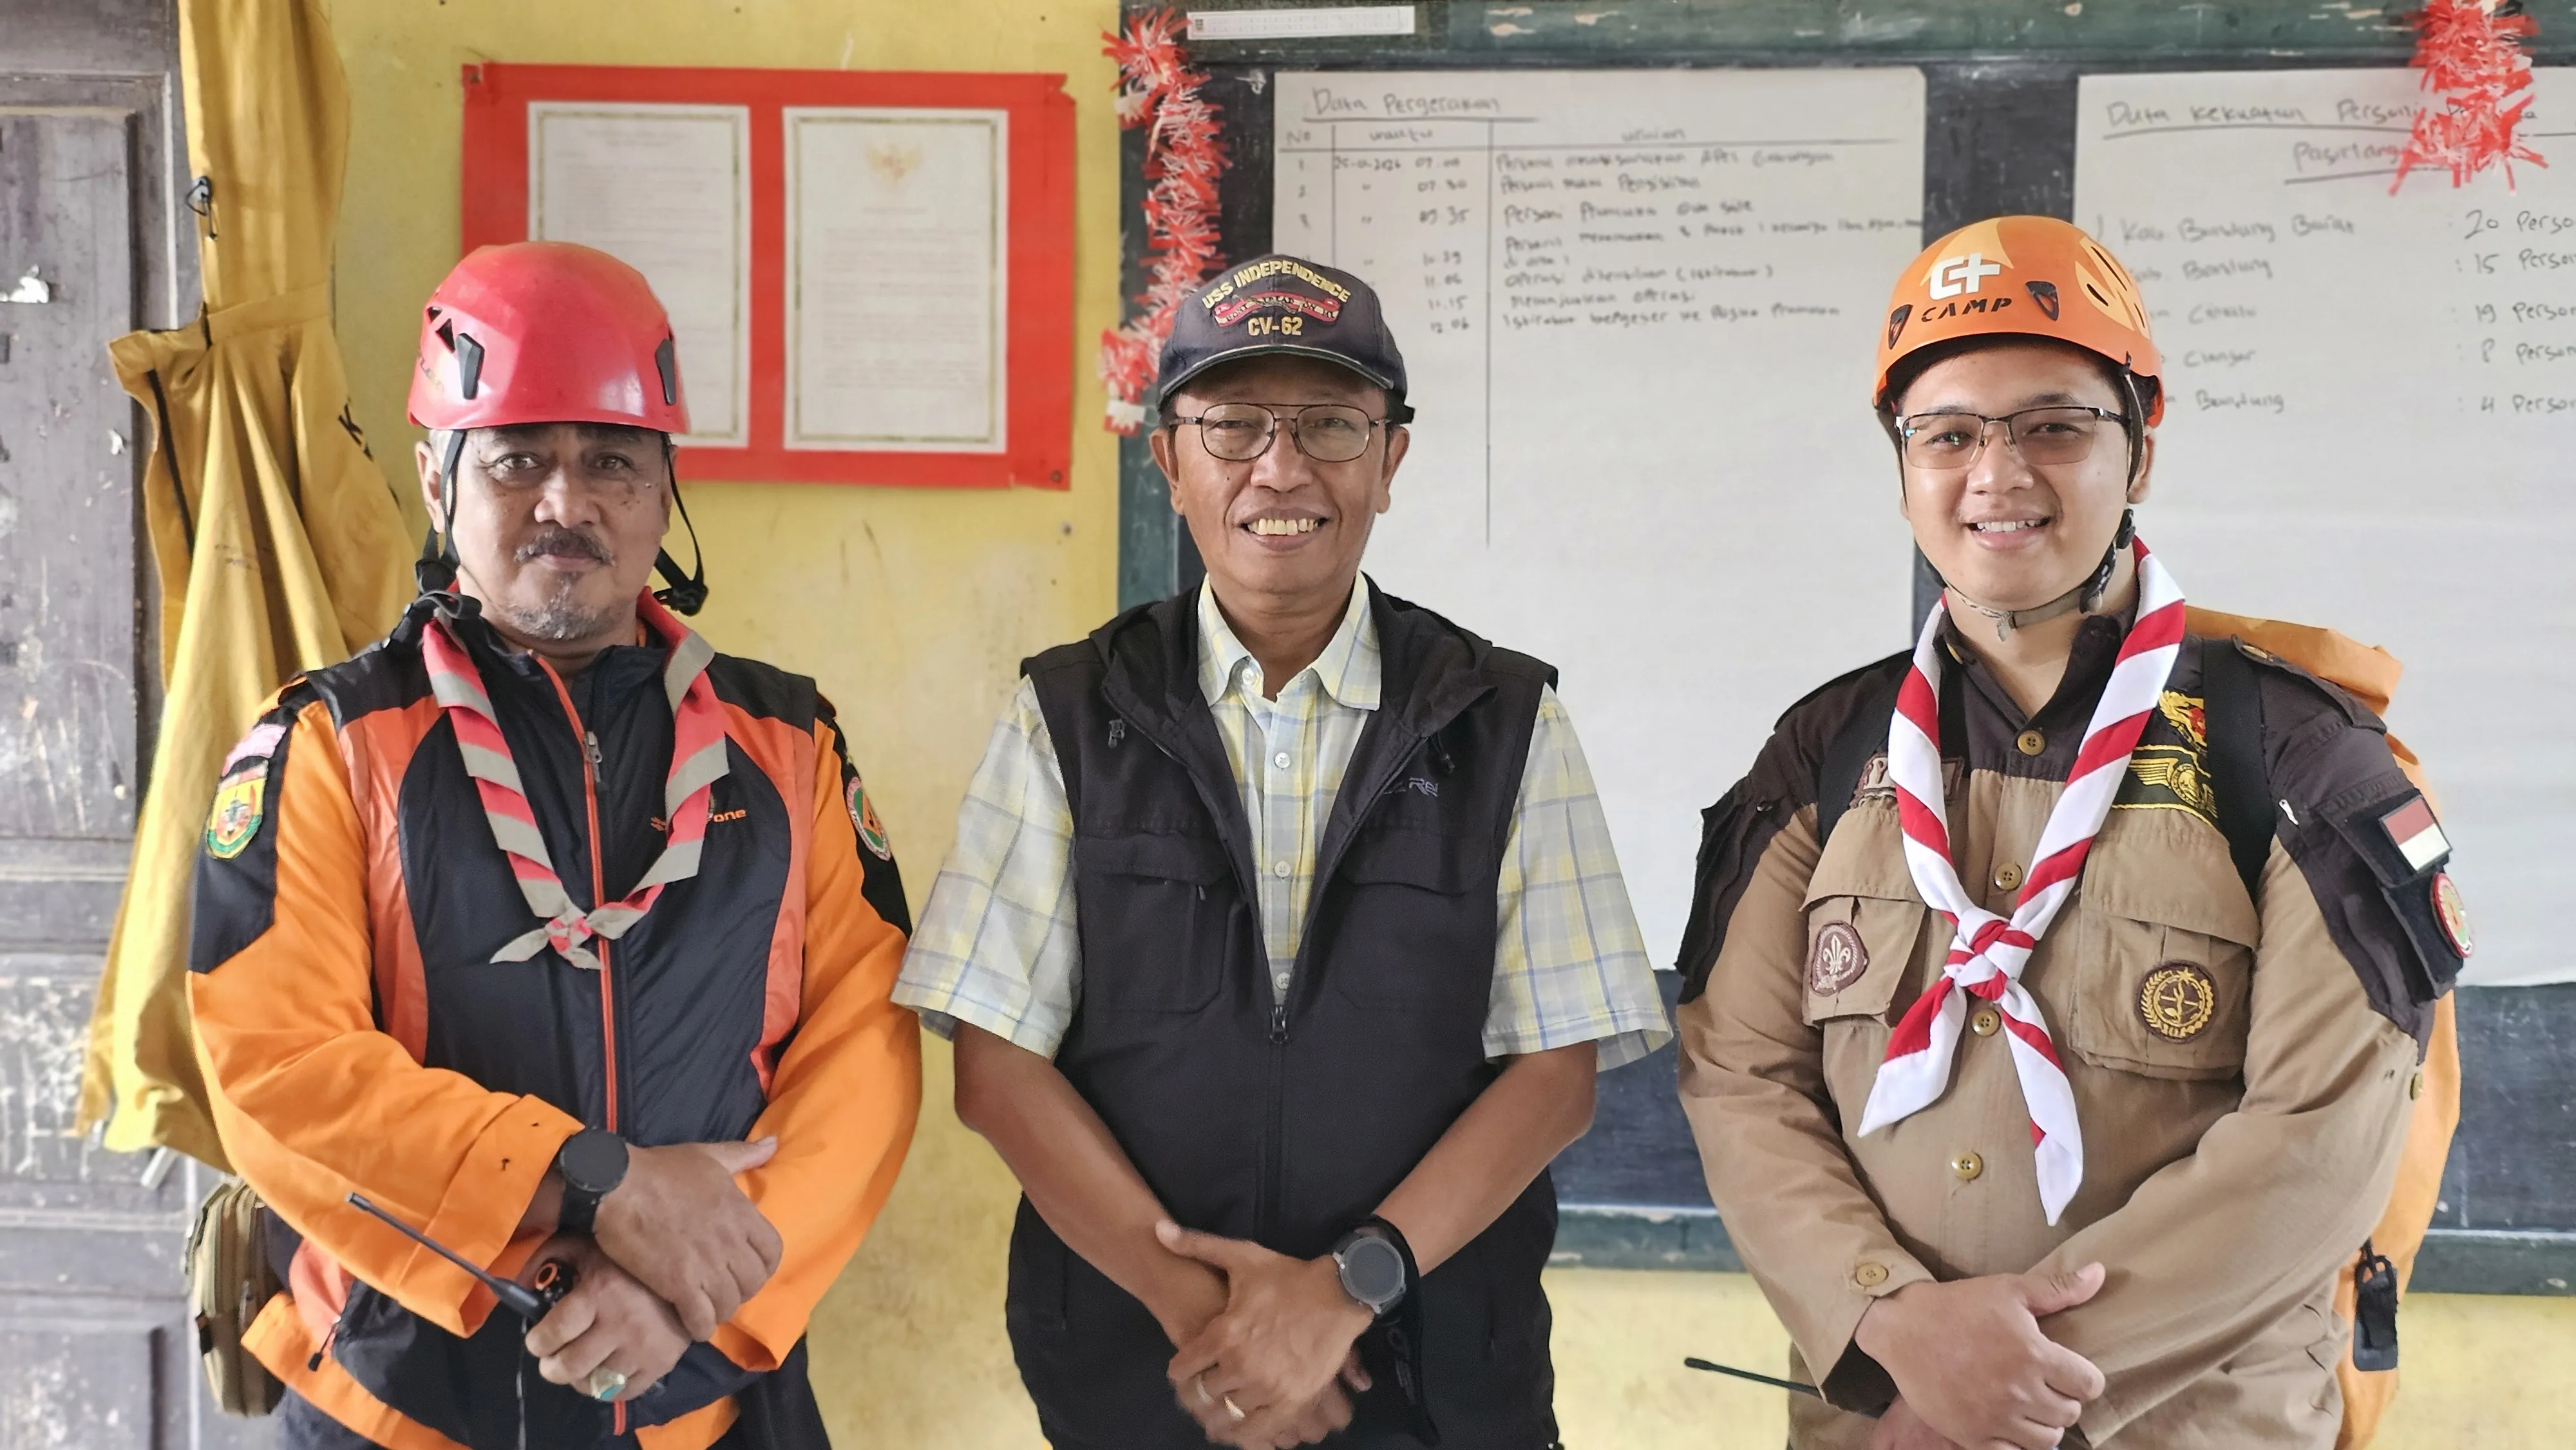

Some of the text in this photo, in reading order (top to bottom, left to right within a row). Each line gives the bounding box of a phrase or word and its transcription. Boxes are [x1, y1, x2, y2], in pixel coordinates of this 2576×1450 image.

[2337, 99, 2426, 123] Personi
[2293, 142, 2402, 173] Pasirlang
[2516, 210, 2576, 235] Perso
[1202, 259, 1351, 309] USS INDEPENDENCE
[1921, 297, 2012, 323] CAMP
[1248, 315, 1303, 337] CV-62
[708, 809, 746, 823] one
